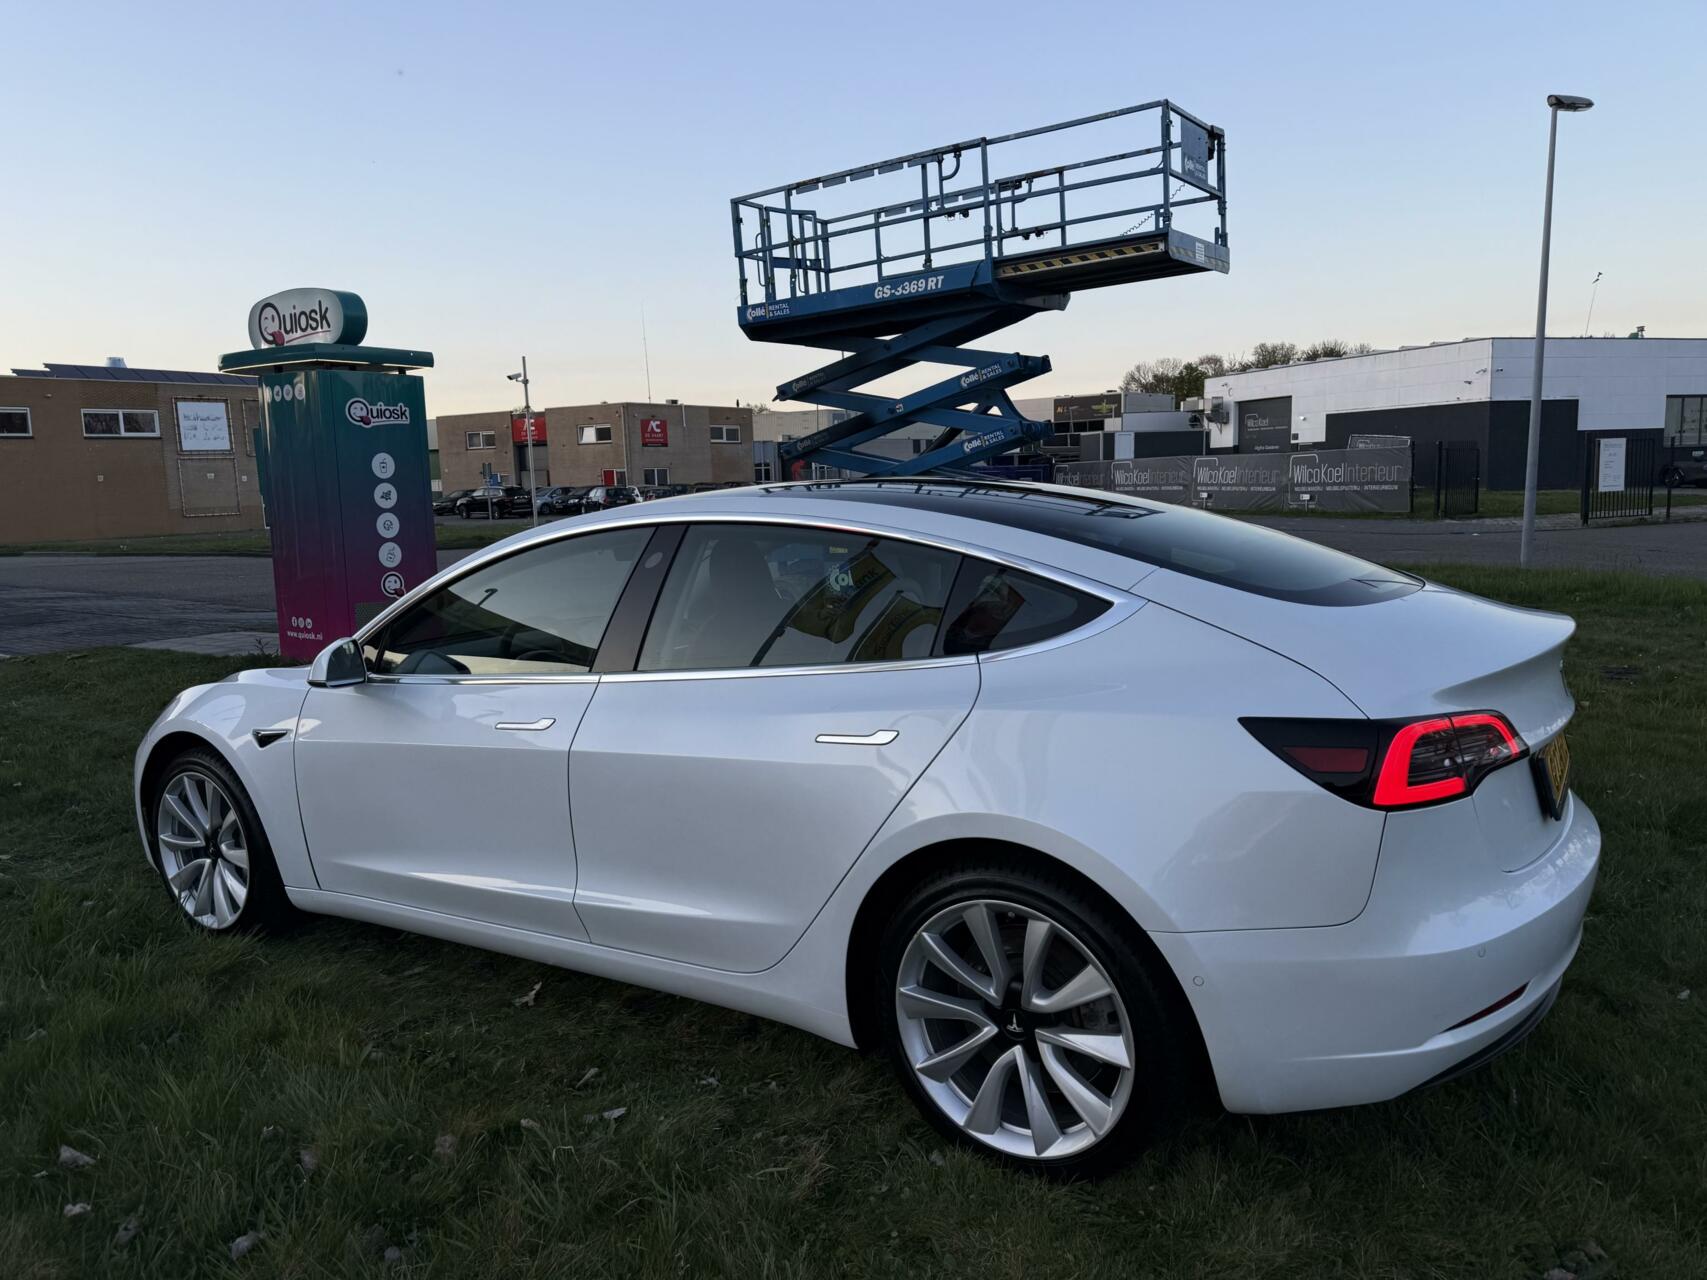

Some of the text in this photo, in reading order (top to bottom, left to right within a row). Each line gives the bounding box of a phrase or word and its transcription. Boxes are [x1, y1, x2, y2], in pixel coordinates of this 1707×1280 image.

[874, 275, 945, 300] GS-3369 RT
[768, 303, 789, 311] RENTAL
[774, 308, 790, 316] SALES
[258, 299, 331, 345] Quiosk
[347, 399, 408, 426] Quiosk
